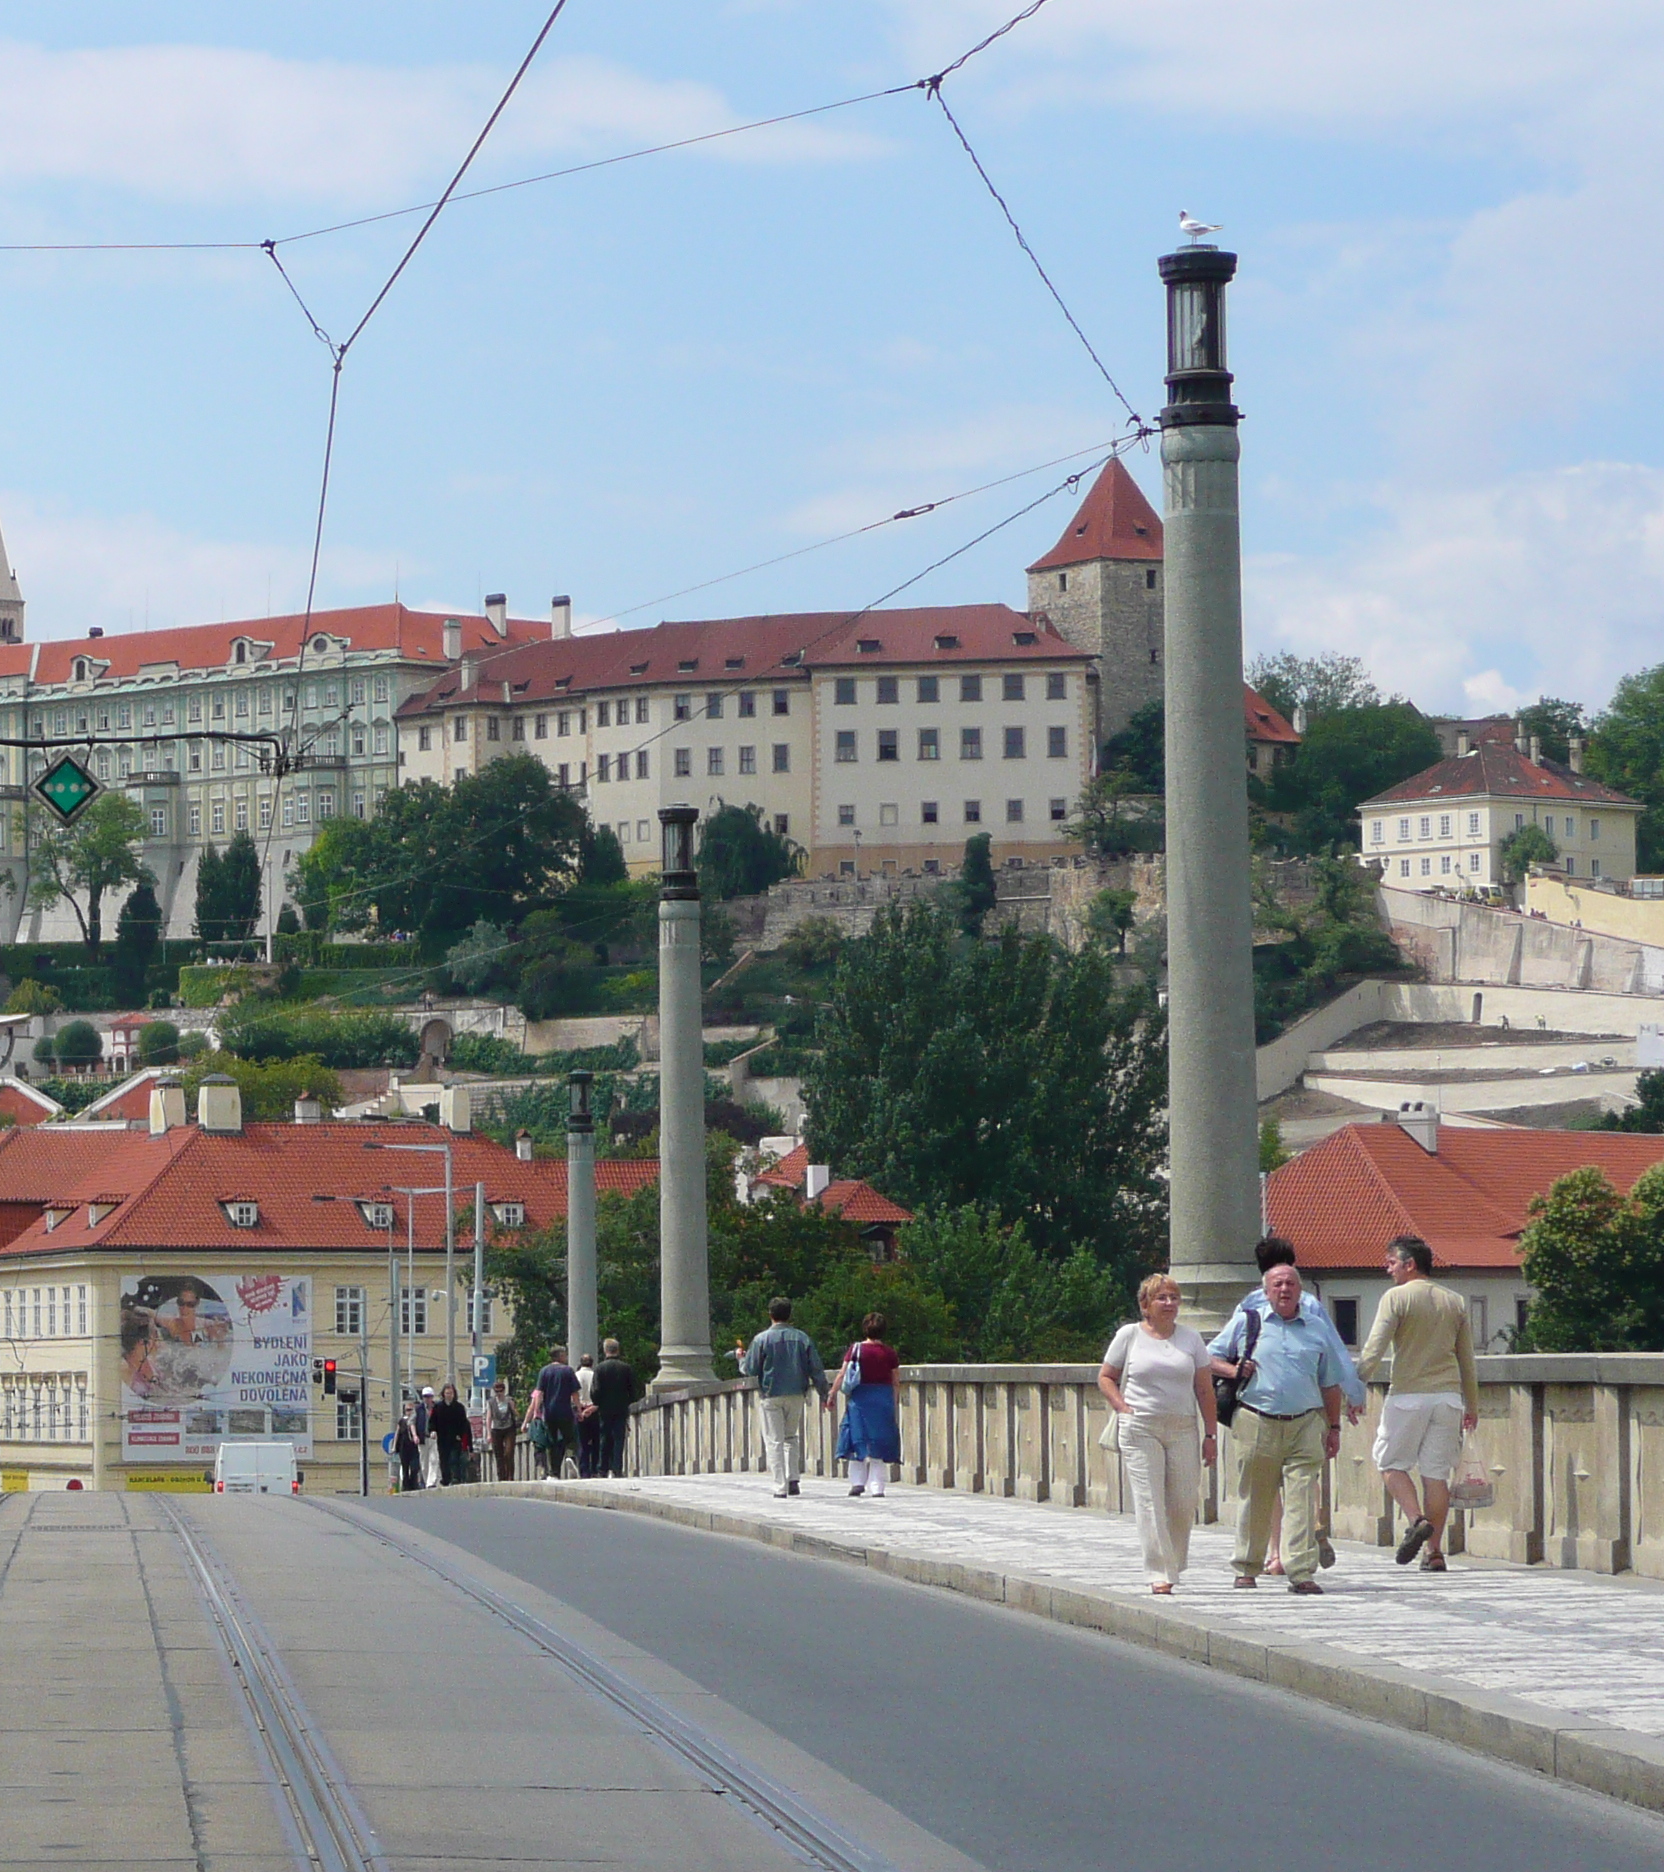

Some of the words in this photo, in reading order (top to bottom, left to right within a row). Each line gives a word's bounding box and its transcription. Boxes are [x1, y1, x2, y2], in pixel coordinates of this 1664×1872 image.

[253, 1334, 307, 1349] BYDLENÍ
[274, 1353, 308, 1367] JAKO
[474, 1356, 489, 1377] P
[231, 1368, 308, 1385] NEKONEČNÁ
